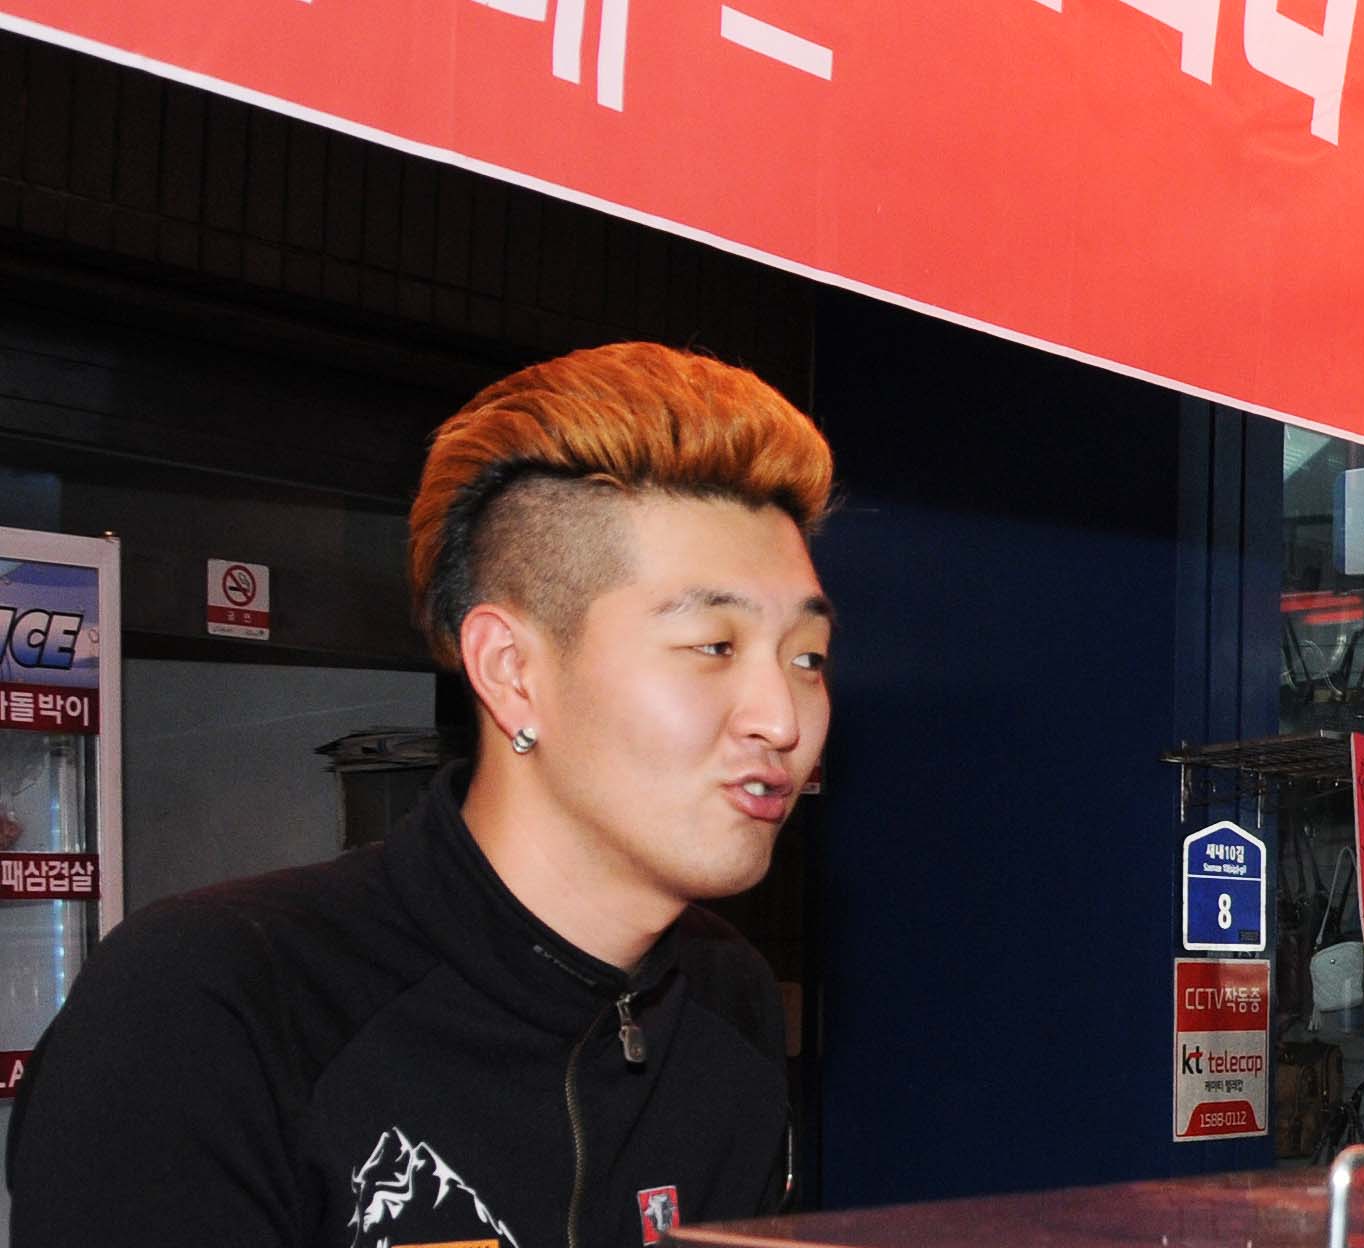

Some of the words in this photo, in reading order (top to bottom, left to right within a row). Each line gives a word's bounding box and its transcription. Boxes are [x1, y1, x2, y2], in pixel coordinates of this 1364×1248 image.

[1218, 893, 1232, 929] 8
[1207, 1050, 1263, 1079] telecop
[1199, 1110, 1248, 1128] 1588-0112
